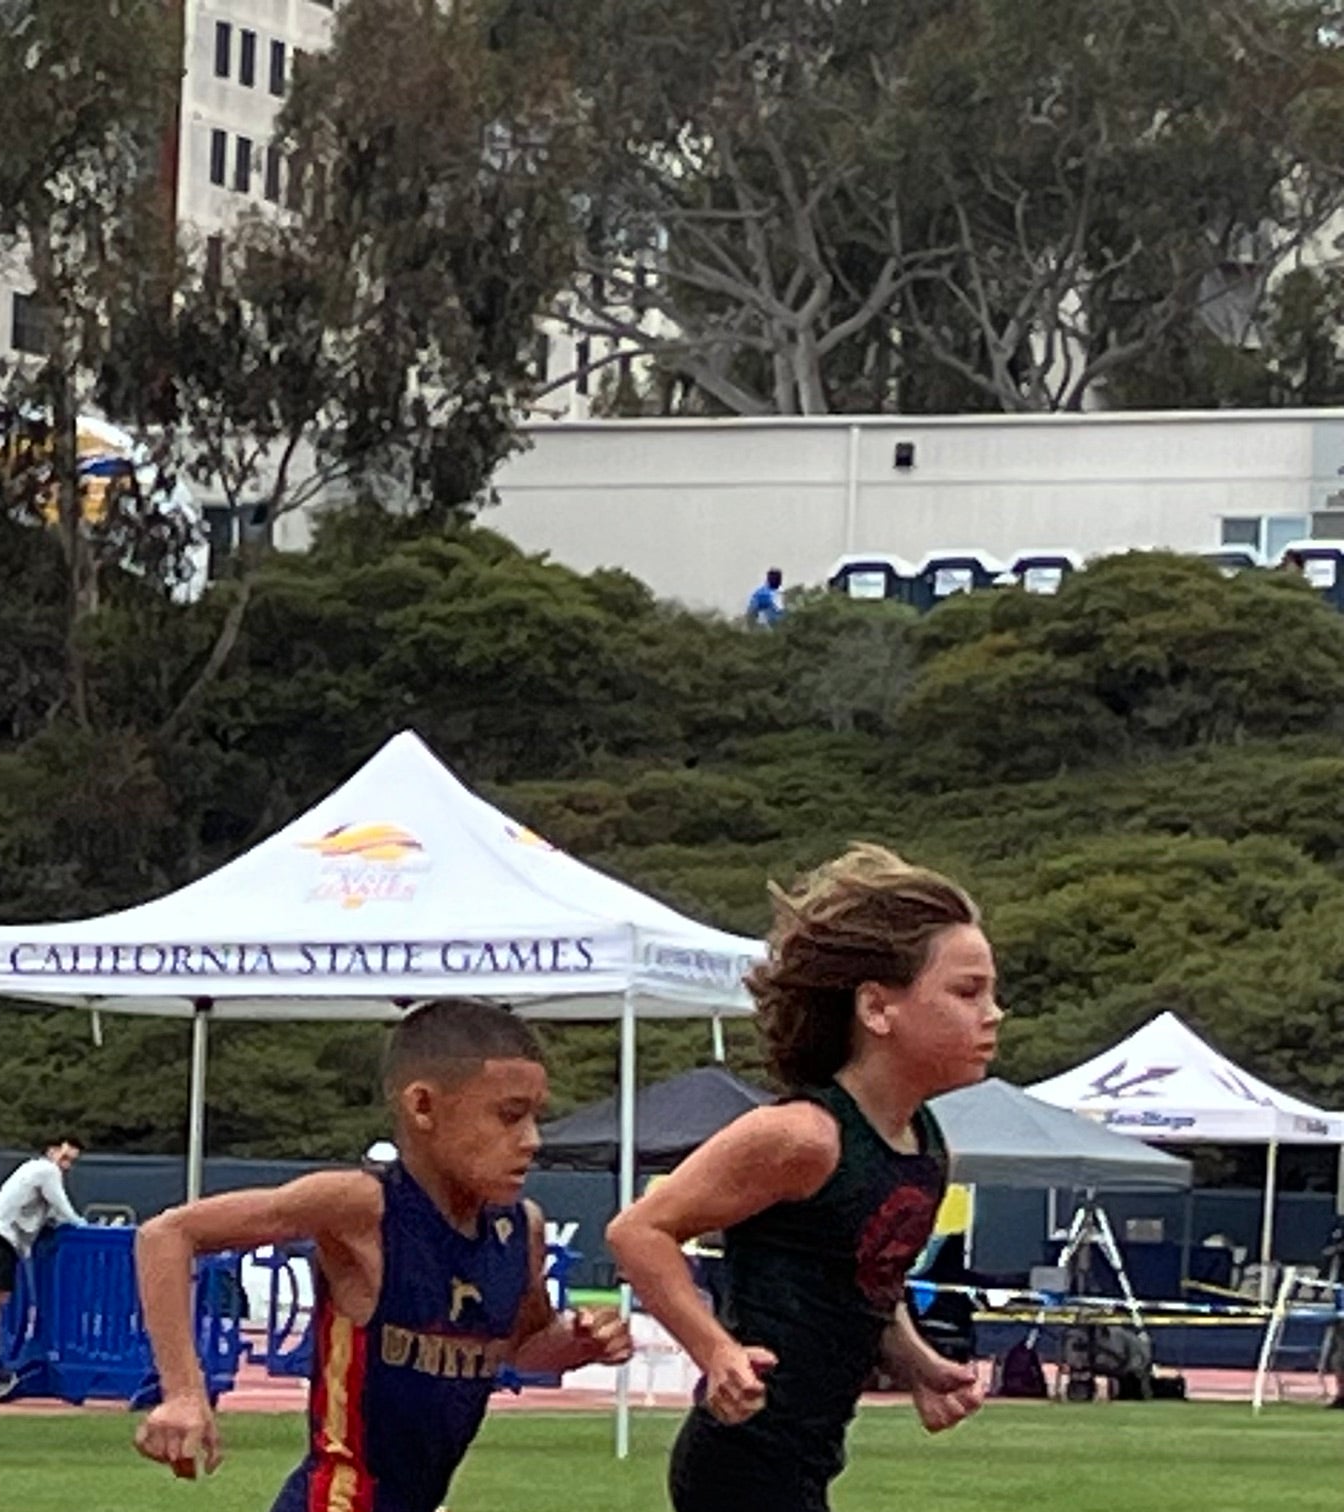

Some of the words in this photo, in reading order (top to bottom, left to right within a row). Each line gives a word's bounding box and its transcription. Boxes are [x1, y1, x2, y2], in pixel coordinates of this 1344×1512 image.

[10, 943, 277, 976] CALIFORNIA
[296, 942, 423, 976] STATE
[441, 938, 594, 973] GAMES
[381, 1323, 492, 1379] UNIT
